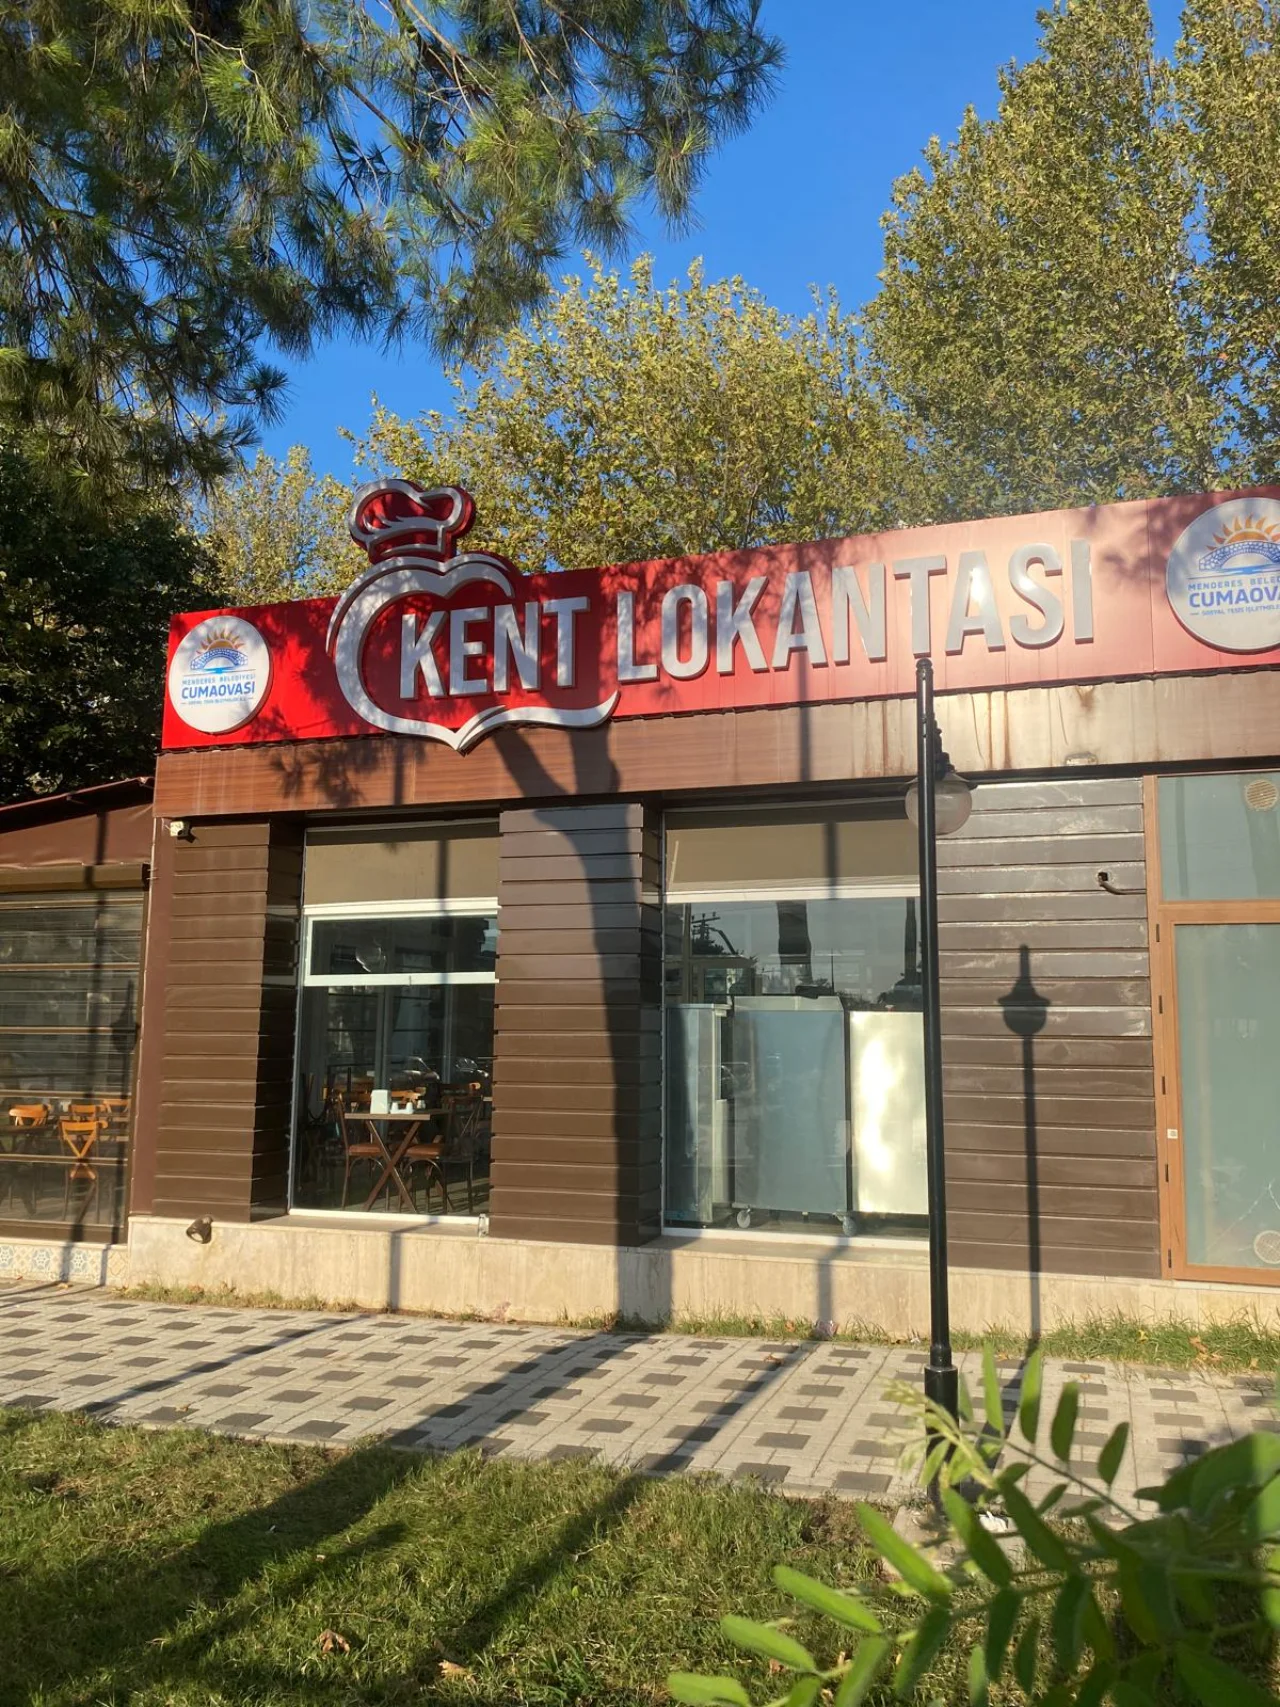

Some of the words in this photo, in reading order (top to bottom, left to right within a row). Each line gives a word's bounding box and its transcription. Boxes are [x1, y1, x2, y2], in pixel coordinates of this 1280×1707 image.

[1188, 580, 1243, 591] MENDERES
[1189, 585, 1280, 608] CUMAOV
[400, 596, 590, 701] KENT
[616, 538, 1094, 686] LOKANTASI
[181, 681, 255, 699] CUMAOVASI
